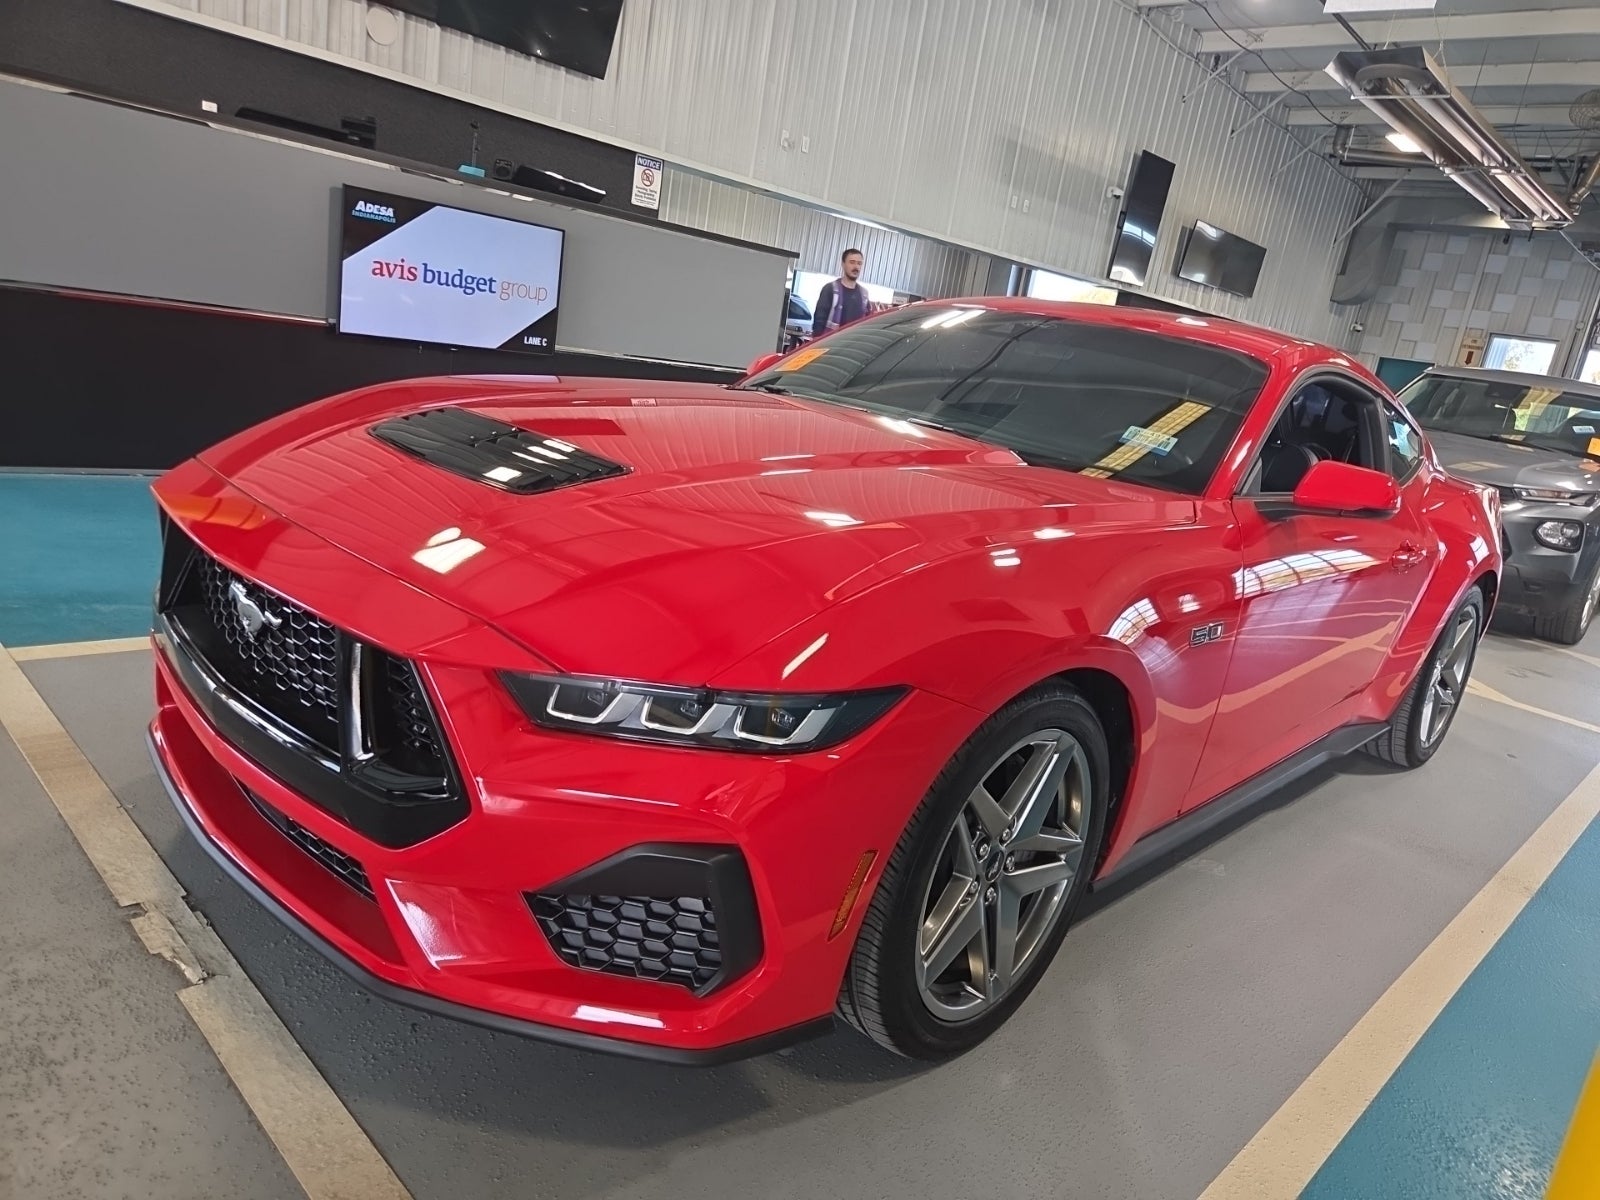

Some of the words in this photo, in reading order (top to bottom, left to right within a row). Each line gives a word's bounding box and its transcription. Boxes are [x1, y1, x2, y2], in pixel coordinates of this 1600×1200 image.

[637, 156, 660, 169] NOTICE
[355, 200, 394, 217] ADESA
[352, 210, 396, 223] INDIANAPOLIS
[371, 258, 418, 282] avis
[422, 263, 497, 295] budget
[499, 280, 548, 305] group
[524, 336, 542, 346] LANE
[542, 338, 548, 346] C
